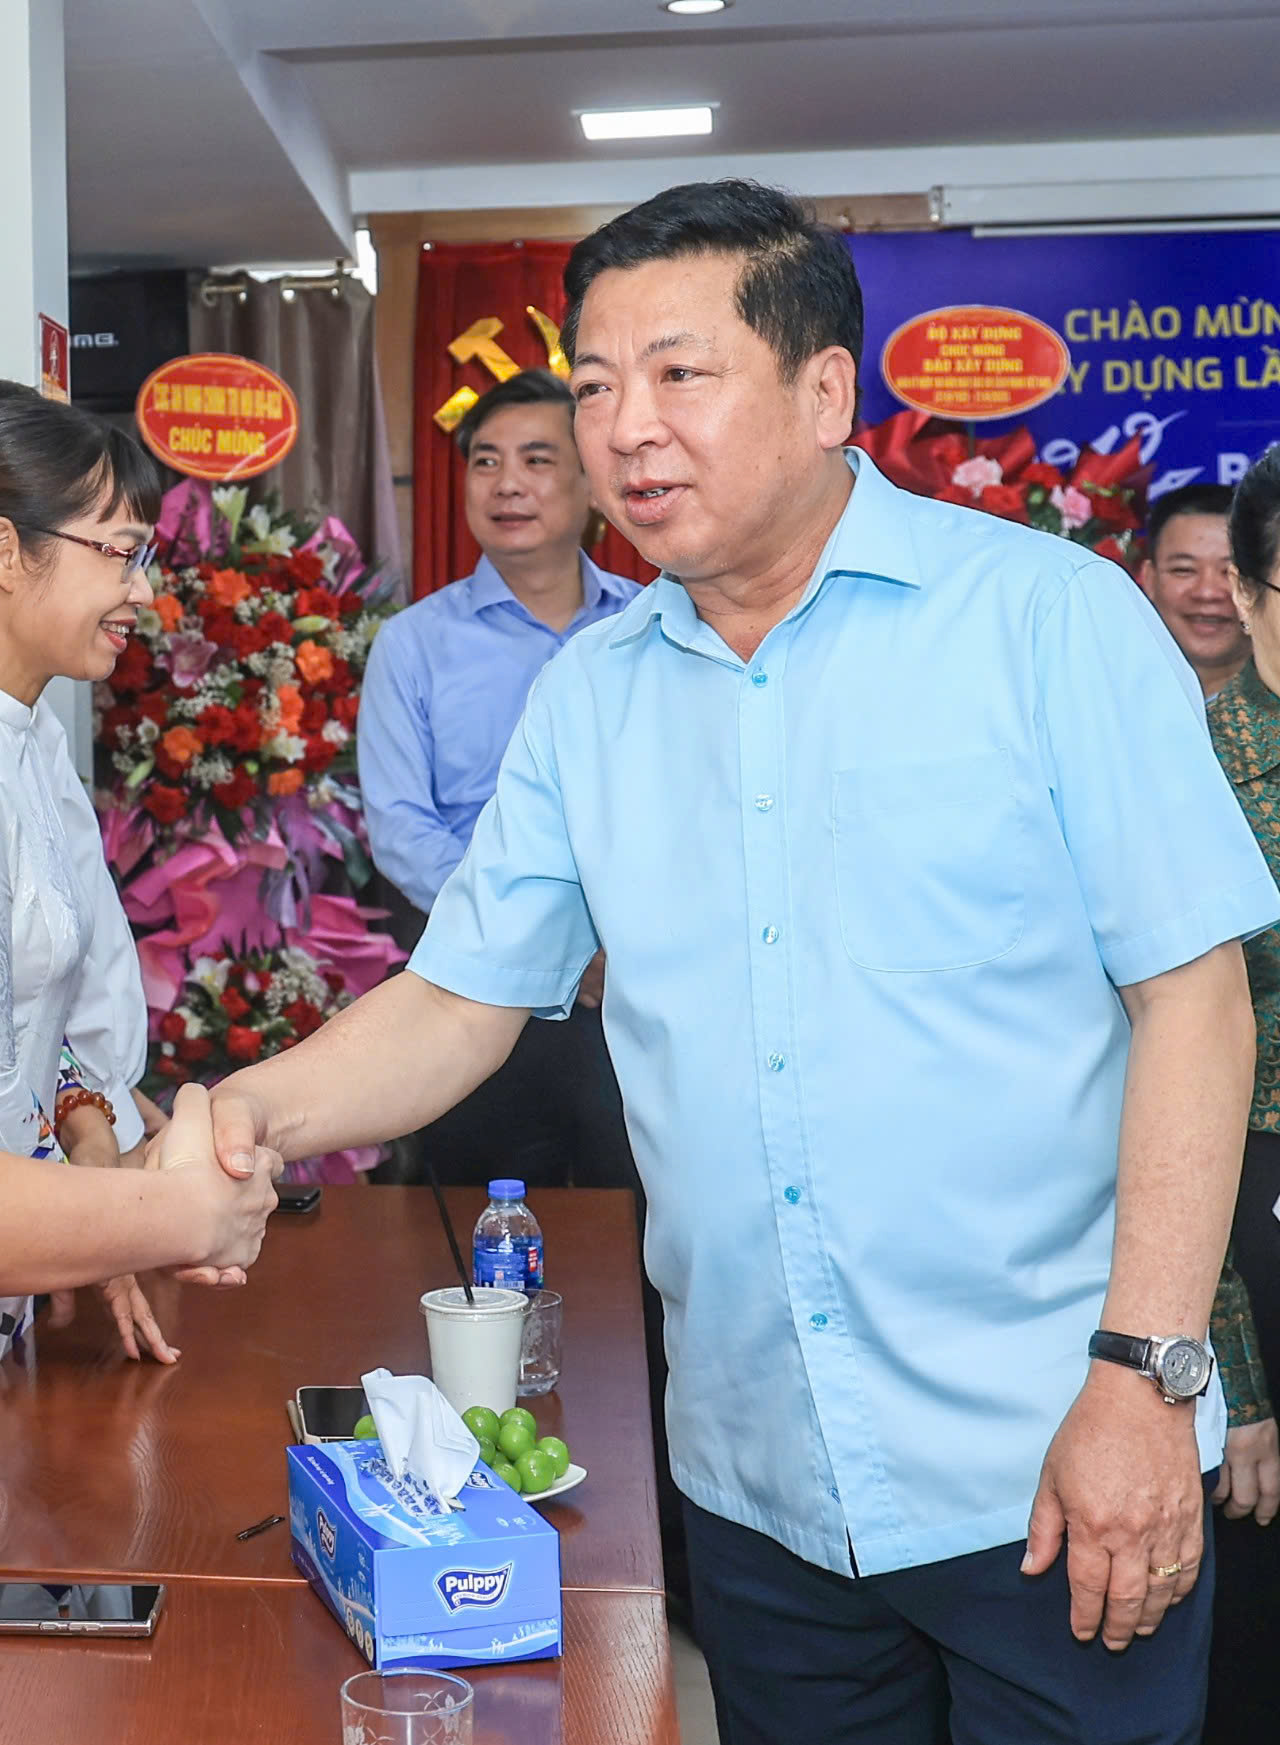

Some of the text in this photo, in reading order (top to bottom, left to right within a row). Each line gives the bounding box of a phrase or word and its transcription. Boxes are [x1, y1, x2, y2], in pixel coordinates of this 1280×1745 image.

[1065, 300, 1182, 342] CHÀO
[1103, 355, 1223, 400] DỰNG
[169, 422, 213, 455] CHÚC
[444, 1573, 505, 1595] Pulppy
